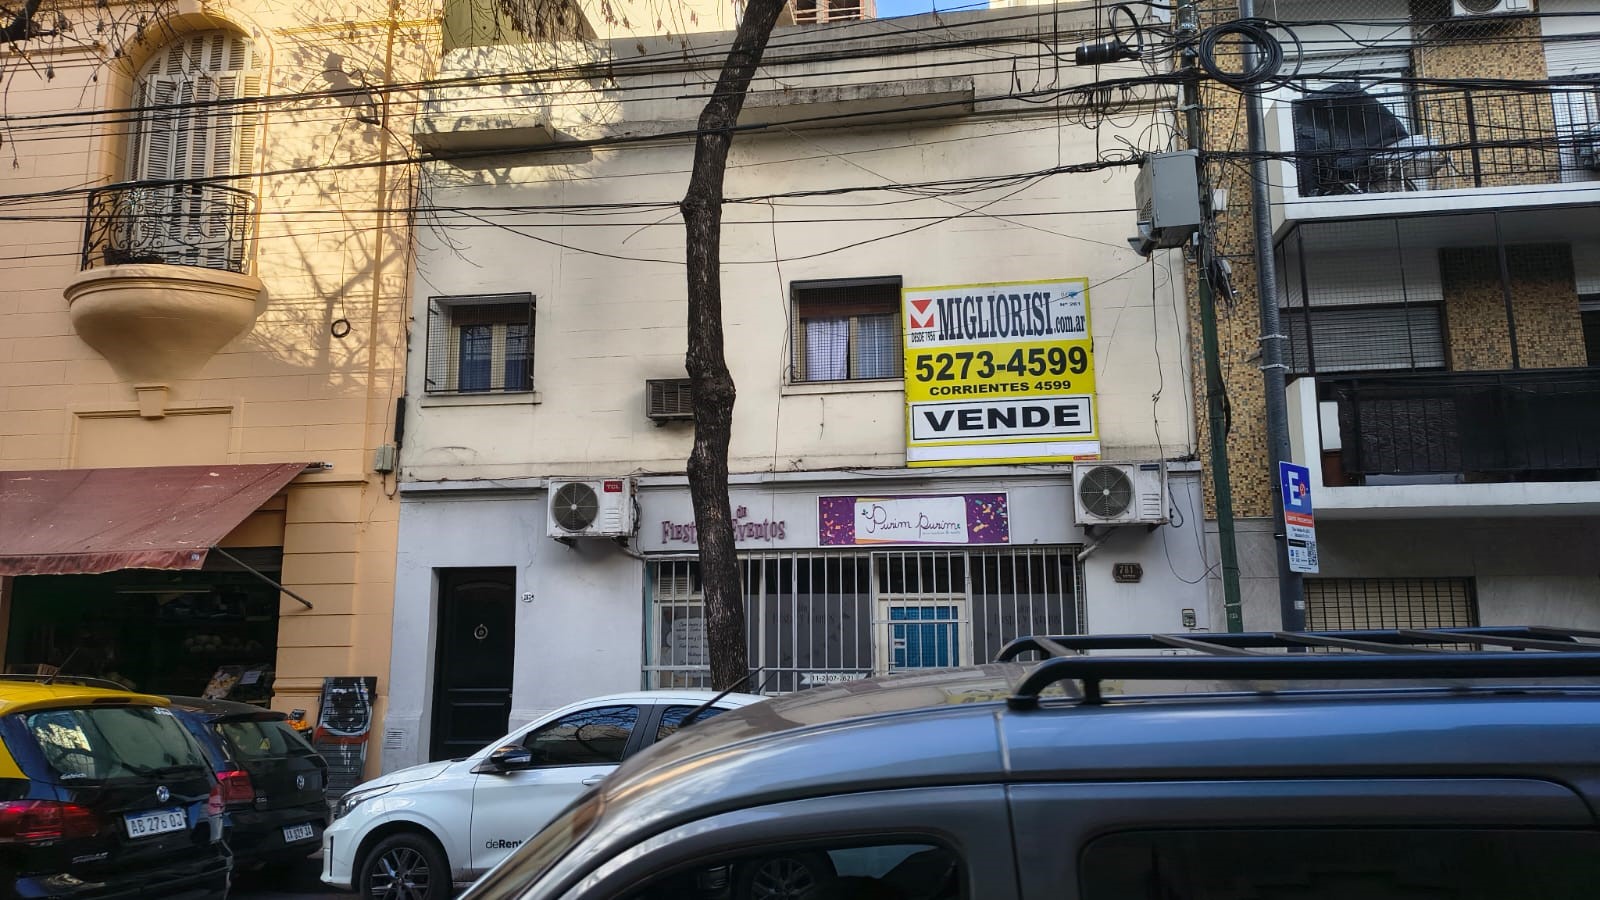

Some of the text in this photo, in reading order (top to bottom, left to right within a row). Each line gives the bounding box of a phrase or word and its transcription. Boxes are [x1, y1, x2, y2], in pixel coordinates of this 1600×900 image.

[916, 346, 1088, 382] 5273-4599
[930, 380, 1071, 396] CORRIENTES 4599
[924, 405, 1081, 432] VENDE
[1288, 470, 1302, 507] E
[131, 819, 145, 835] AB
